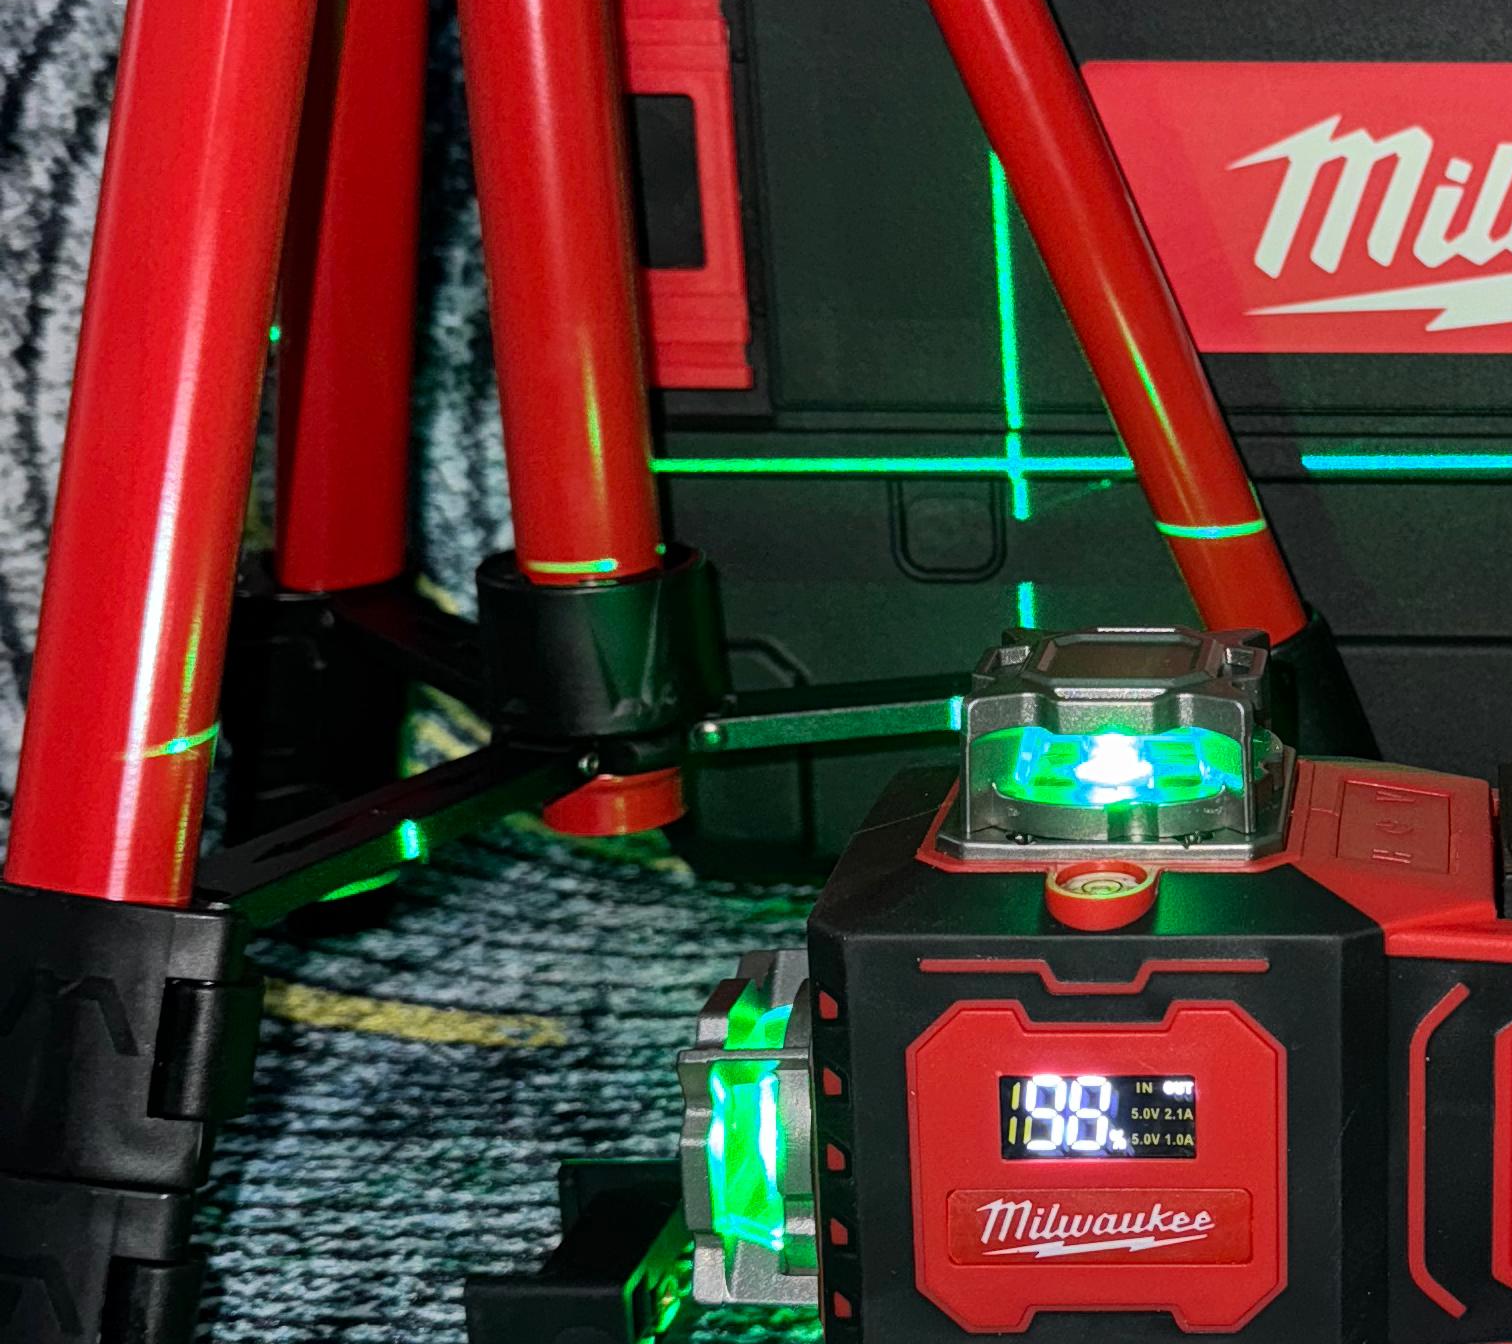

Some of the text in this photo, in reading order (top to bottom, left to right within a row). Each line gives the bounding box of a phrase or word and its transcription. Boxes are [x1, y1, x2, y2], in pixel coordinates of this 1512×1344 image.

[1135, 1081, 1153, 1094] IN
[1131, 1107, 1193, 1120] 5.0V 2.1A
[1131, 1133, 1194, 1146] 5.0V 1.0A
[976, 1197, 1216, 1244] Milwaukee
